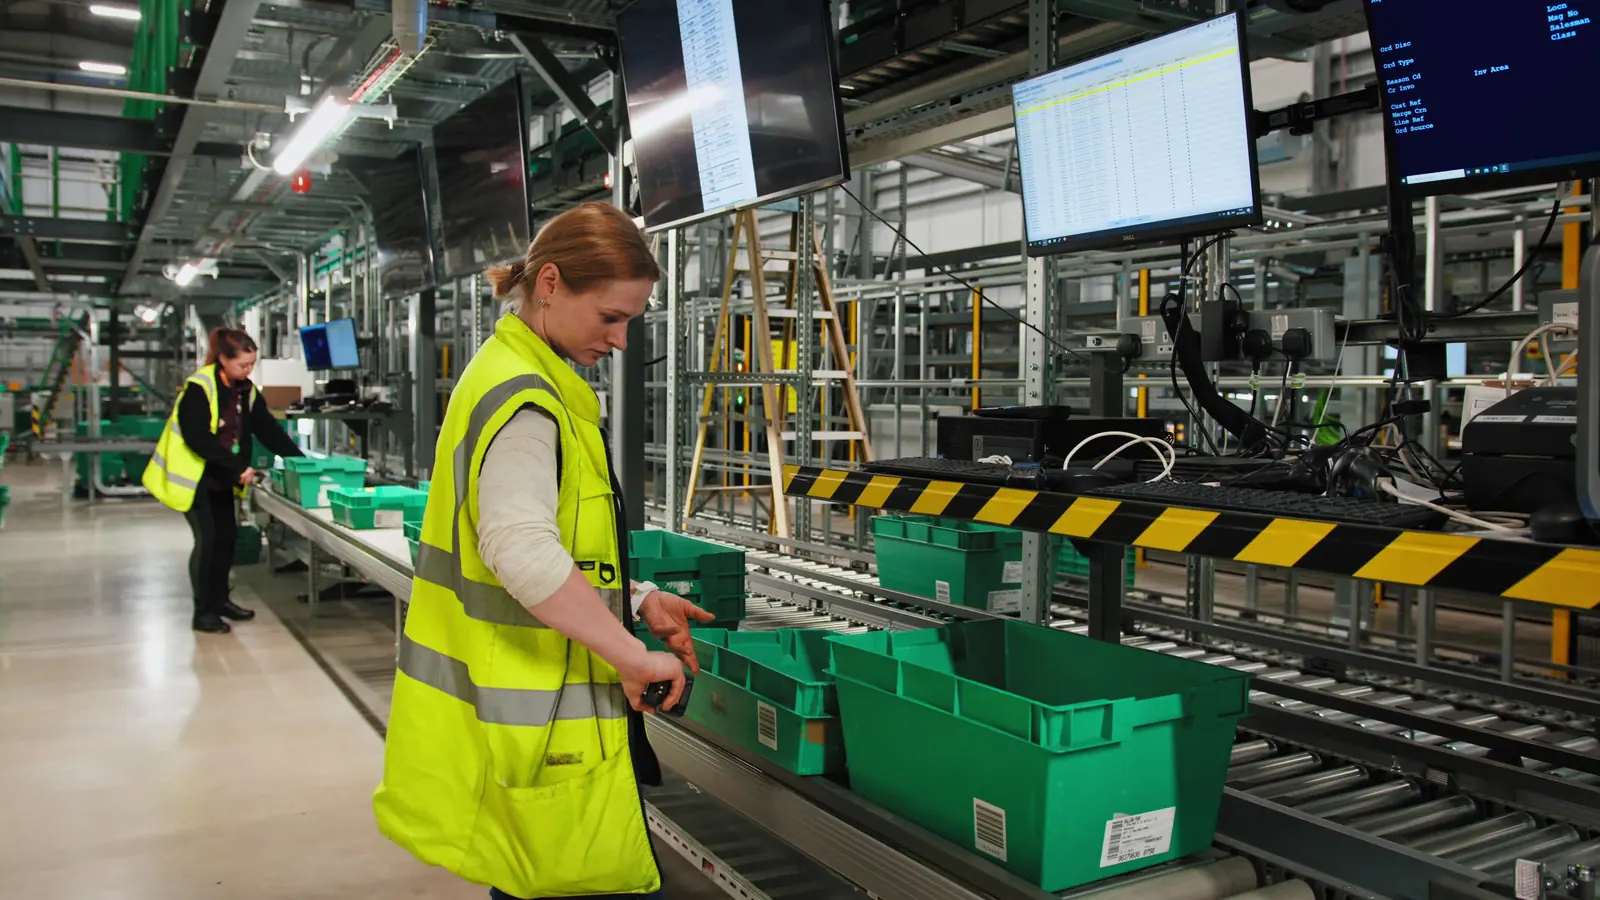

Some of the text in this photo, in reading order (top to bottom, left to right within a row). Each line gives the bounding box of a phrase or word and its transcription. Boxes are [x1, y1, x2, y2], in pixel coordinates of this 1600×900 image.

[1547, 3, 1567, 12] Locn
[1548, 14, 1564, 22] Msg
[1550, 18, 1590, 31] Salesman
[1551, 31, 1576, 40] Class
[1395, 41, 1411, 49] Disc
[1383, 58, 1414, 69] Ord Type
[1490, 65, 1509, 73] Area
[1386, 77, 1410, 85] Reason
[1392, 110, 1411, 118] Merge
[1412, 115, 1424, 123] Ref
